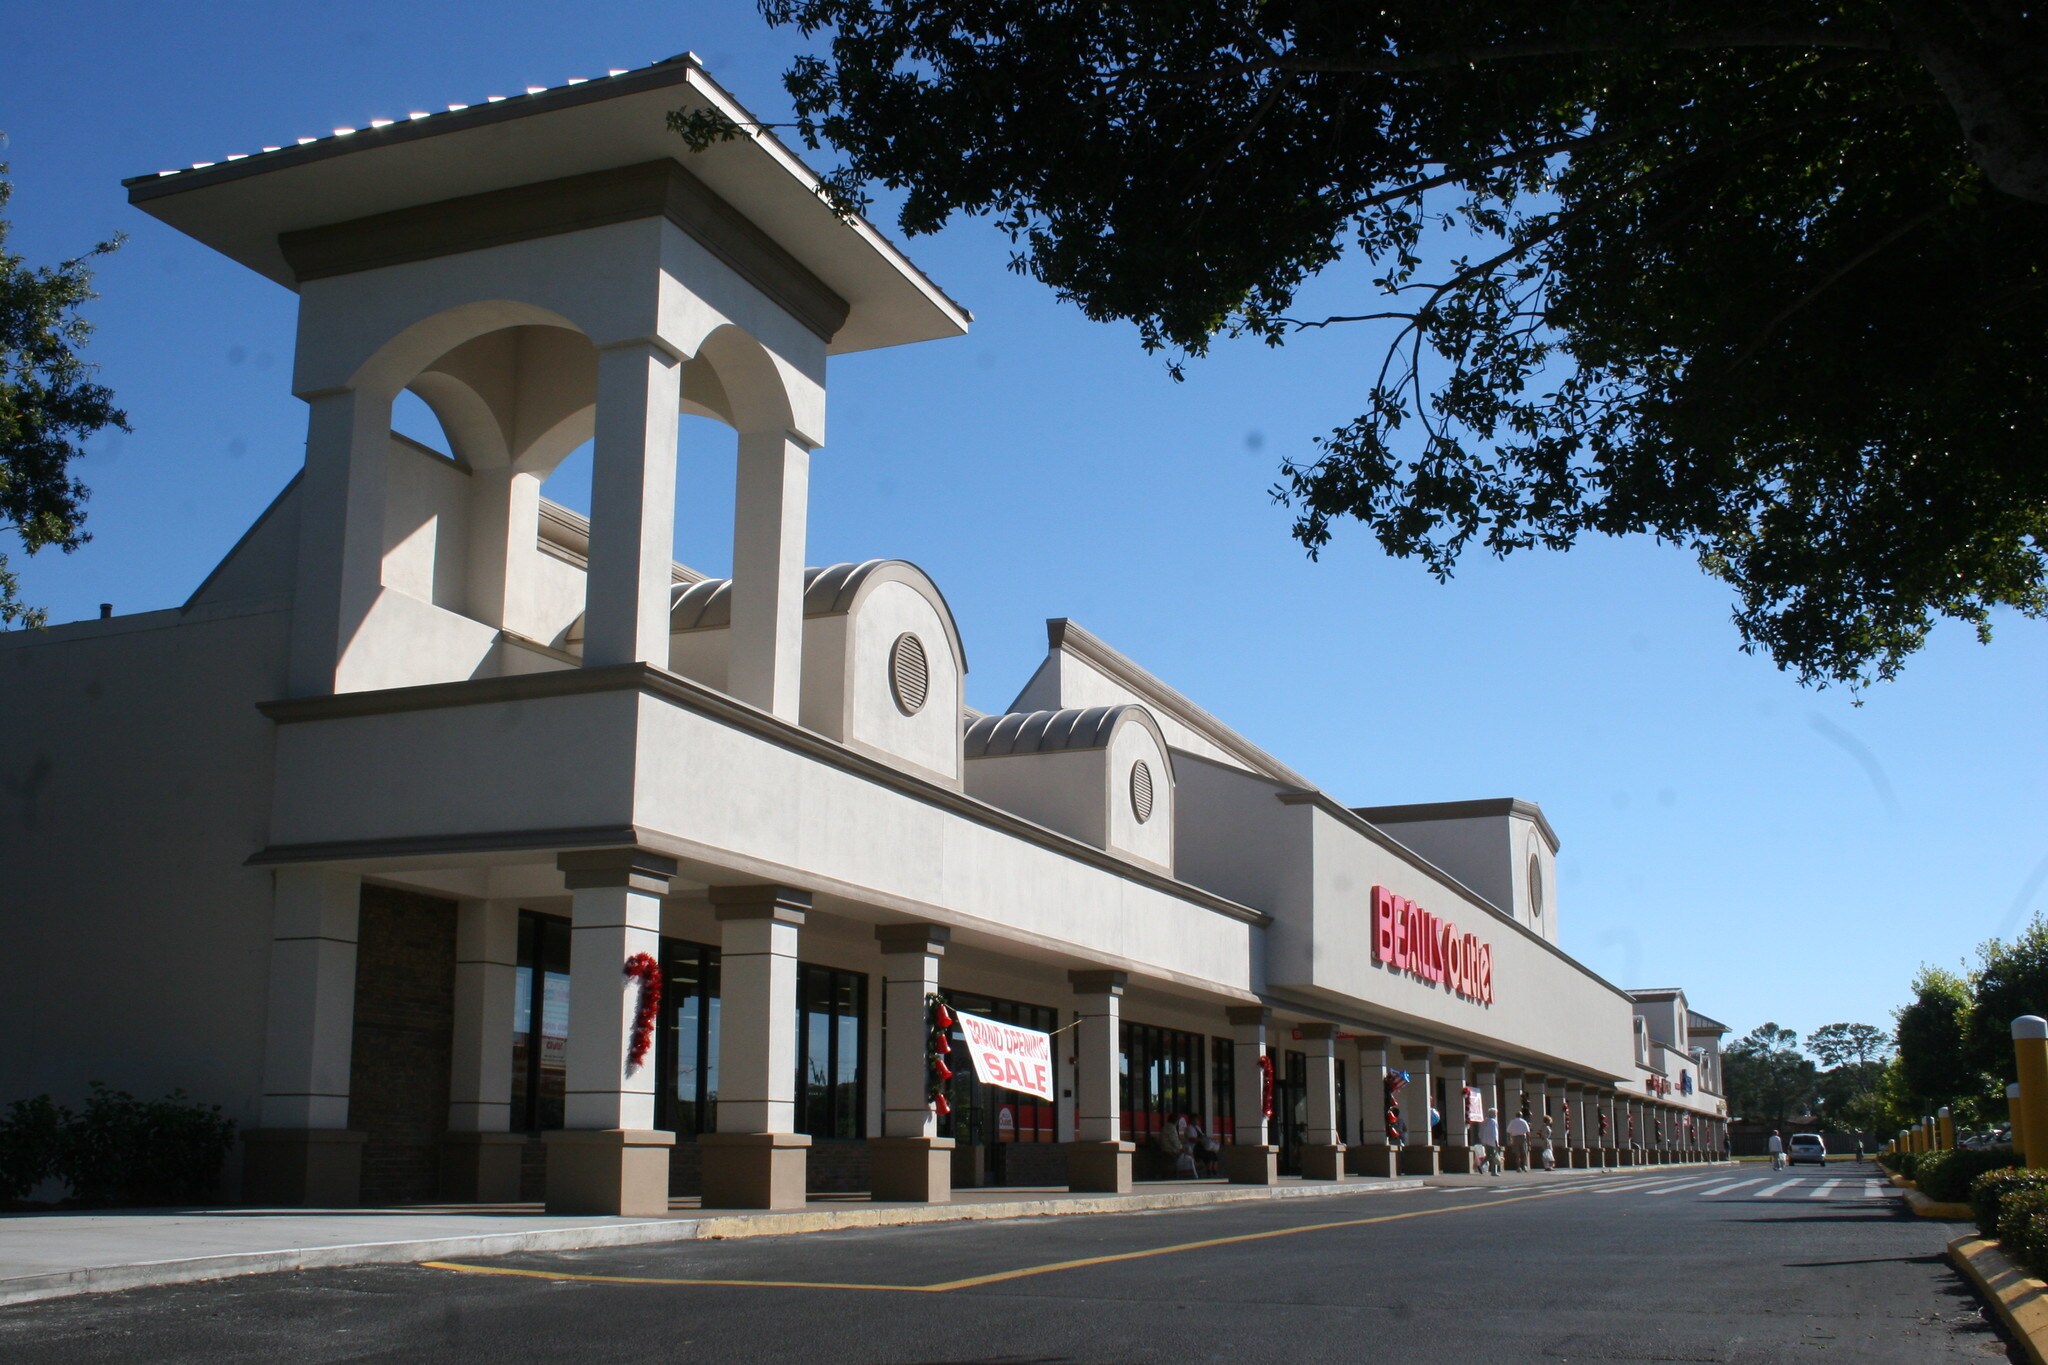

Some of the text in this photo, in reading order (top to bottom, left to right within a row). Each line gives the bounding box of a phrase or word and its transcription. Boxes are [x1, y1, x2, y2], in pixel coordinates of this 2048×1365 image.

[1371, 885, 1445, 984] BEALLS
[966, 1018, 1048, 1061] GRAND OPENING
[983, 1052, 1047, 1093] SALE
